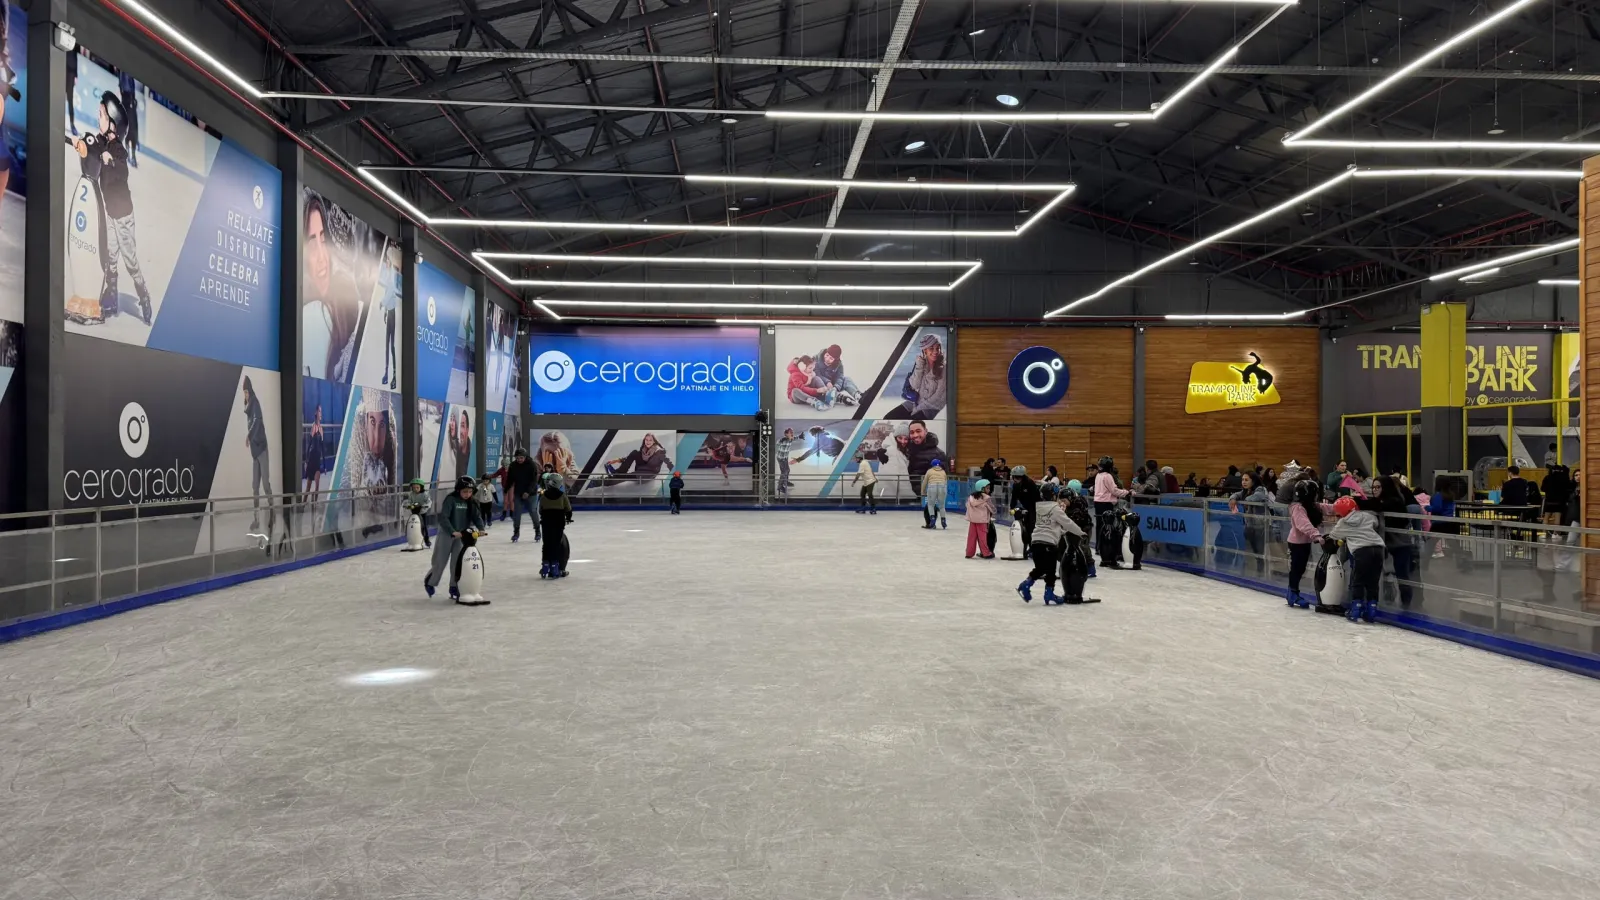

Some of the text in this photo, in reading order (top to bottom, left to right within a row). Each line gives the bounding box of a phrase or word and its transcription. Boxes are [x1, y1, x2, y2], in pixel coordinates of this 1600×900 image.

[79, 184, 88, 202] 2
[227, 209, 274, 245] RELÁJATE
[217, 229, 266, 265] DISFRUTA
[208, 253, 259, 286] CELEBRA
[199, 276, 250, 306] APRENDE
[578, 355, 755, 391] cerogrado
[1465, 364, 1538, 392] PARK
[1190, 384, 1257, 393] TRAMPOLINE
[1227, 392, 1256, 401] PARK
[63, 458, 194, 505] cerogrado
[1146, 515, 1187, 533] SALIDA
